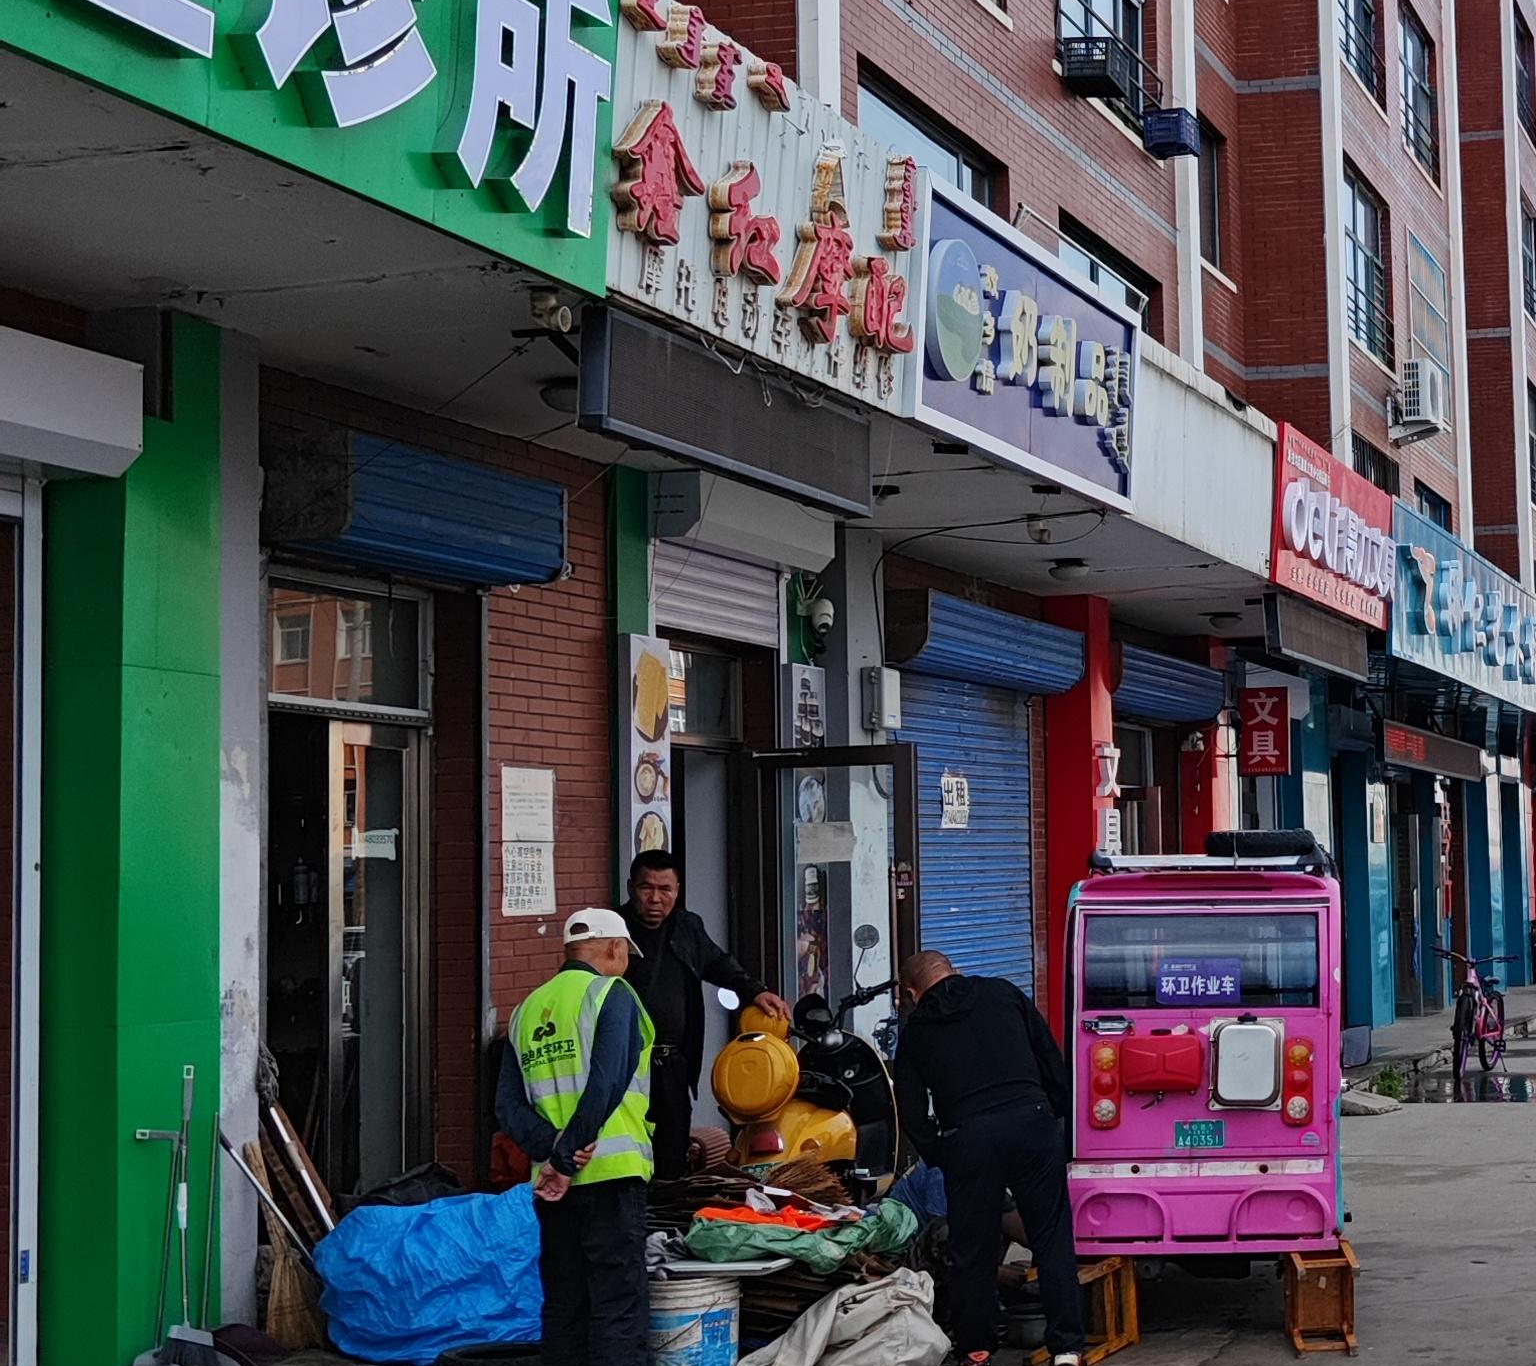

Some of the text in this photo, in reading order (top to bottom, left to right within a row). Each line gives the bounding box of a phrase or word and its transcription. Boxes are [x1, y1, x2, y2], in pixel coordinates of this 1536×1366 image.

[639, 243, 893, 400] 摩托电动车件维修
[1000, 295, 1108, 427] 奶制品
[1247, 692, 1280, 764] 文具
[943, 780, 966, 806] 出租
[1161, 975, 1235, 996] 环卫作业车
